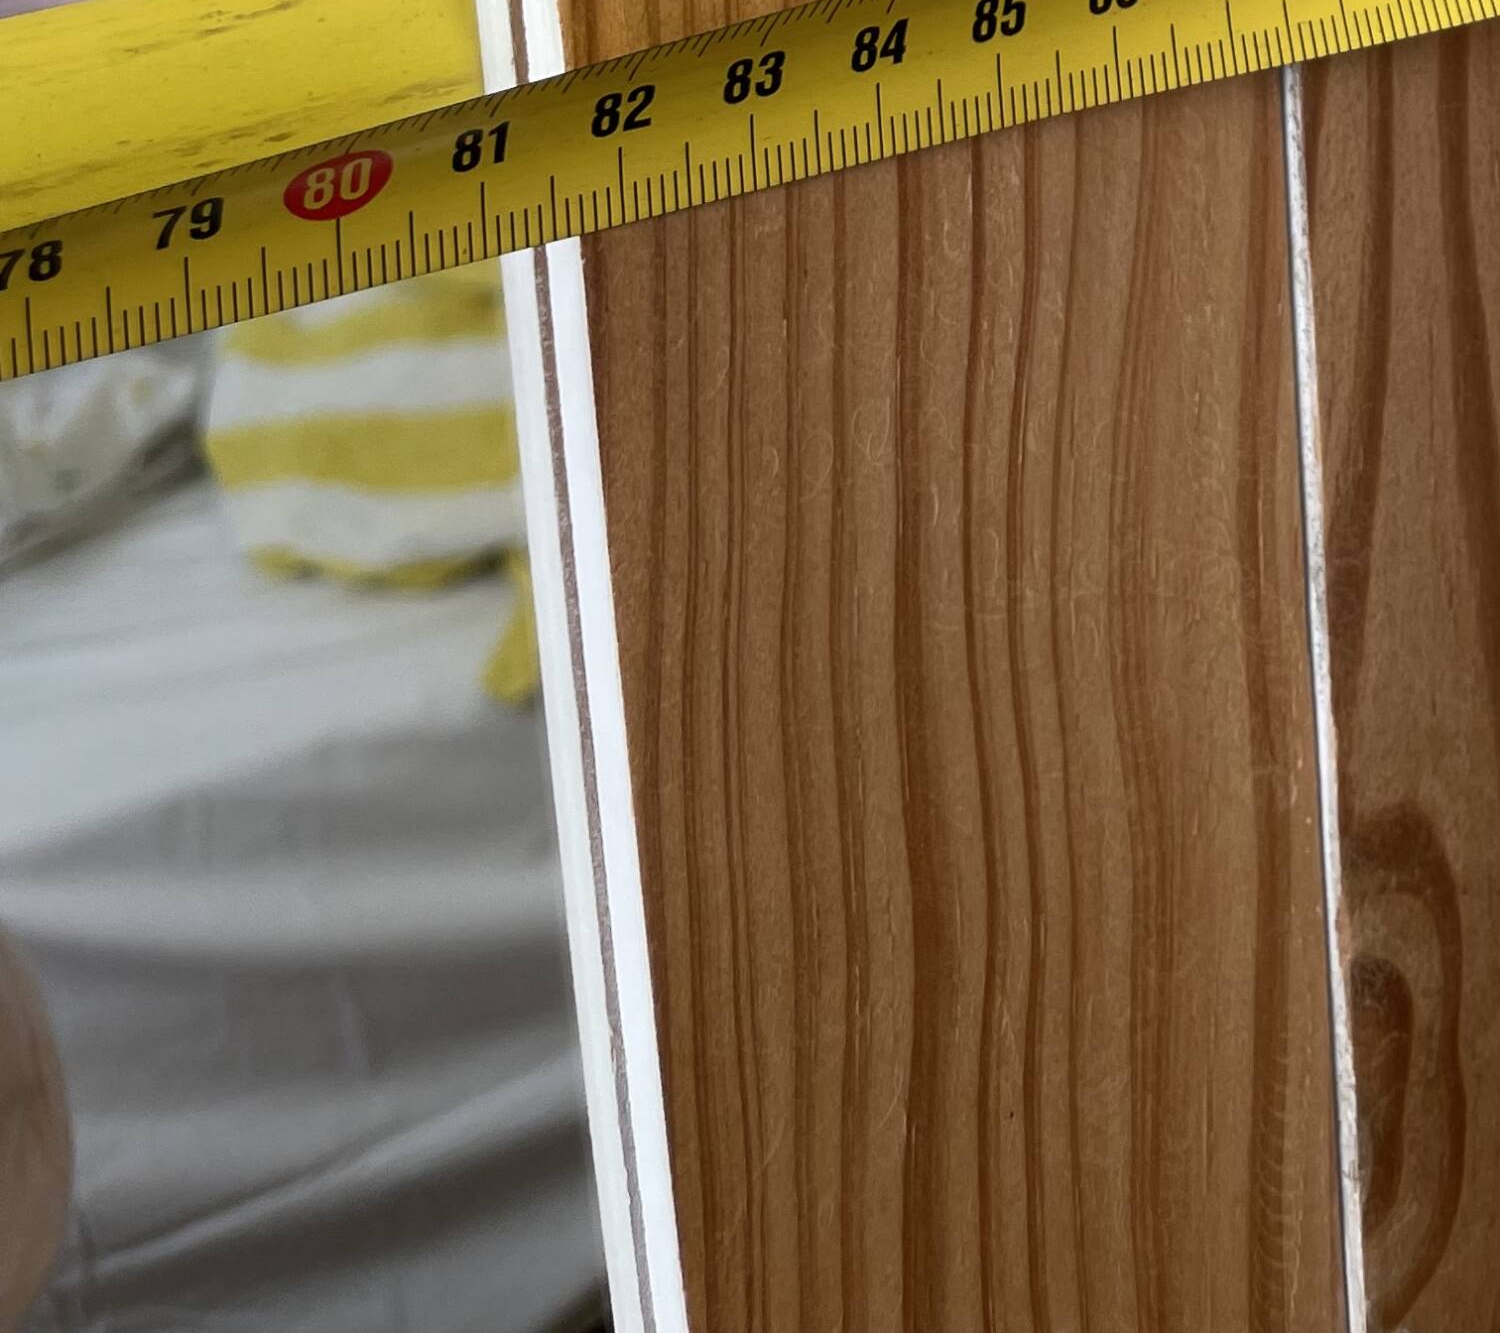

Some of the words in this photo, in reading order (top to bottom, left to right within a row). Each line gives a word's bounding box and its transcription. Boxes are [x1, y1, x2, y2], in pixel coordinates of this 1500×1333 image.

[0, 239, 64, 292] 78
[151, 196, 225, 251] 79
[303, 157, 373, 210] 80
[451, 120, 510, 173] 81
[591, 84, 656, 138] 82
[723, 50, 786, 105] 83
[851, 17, 909, 73] 84
